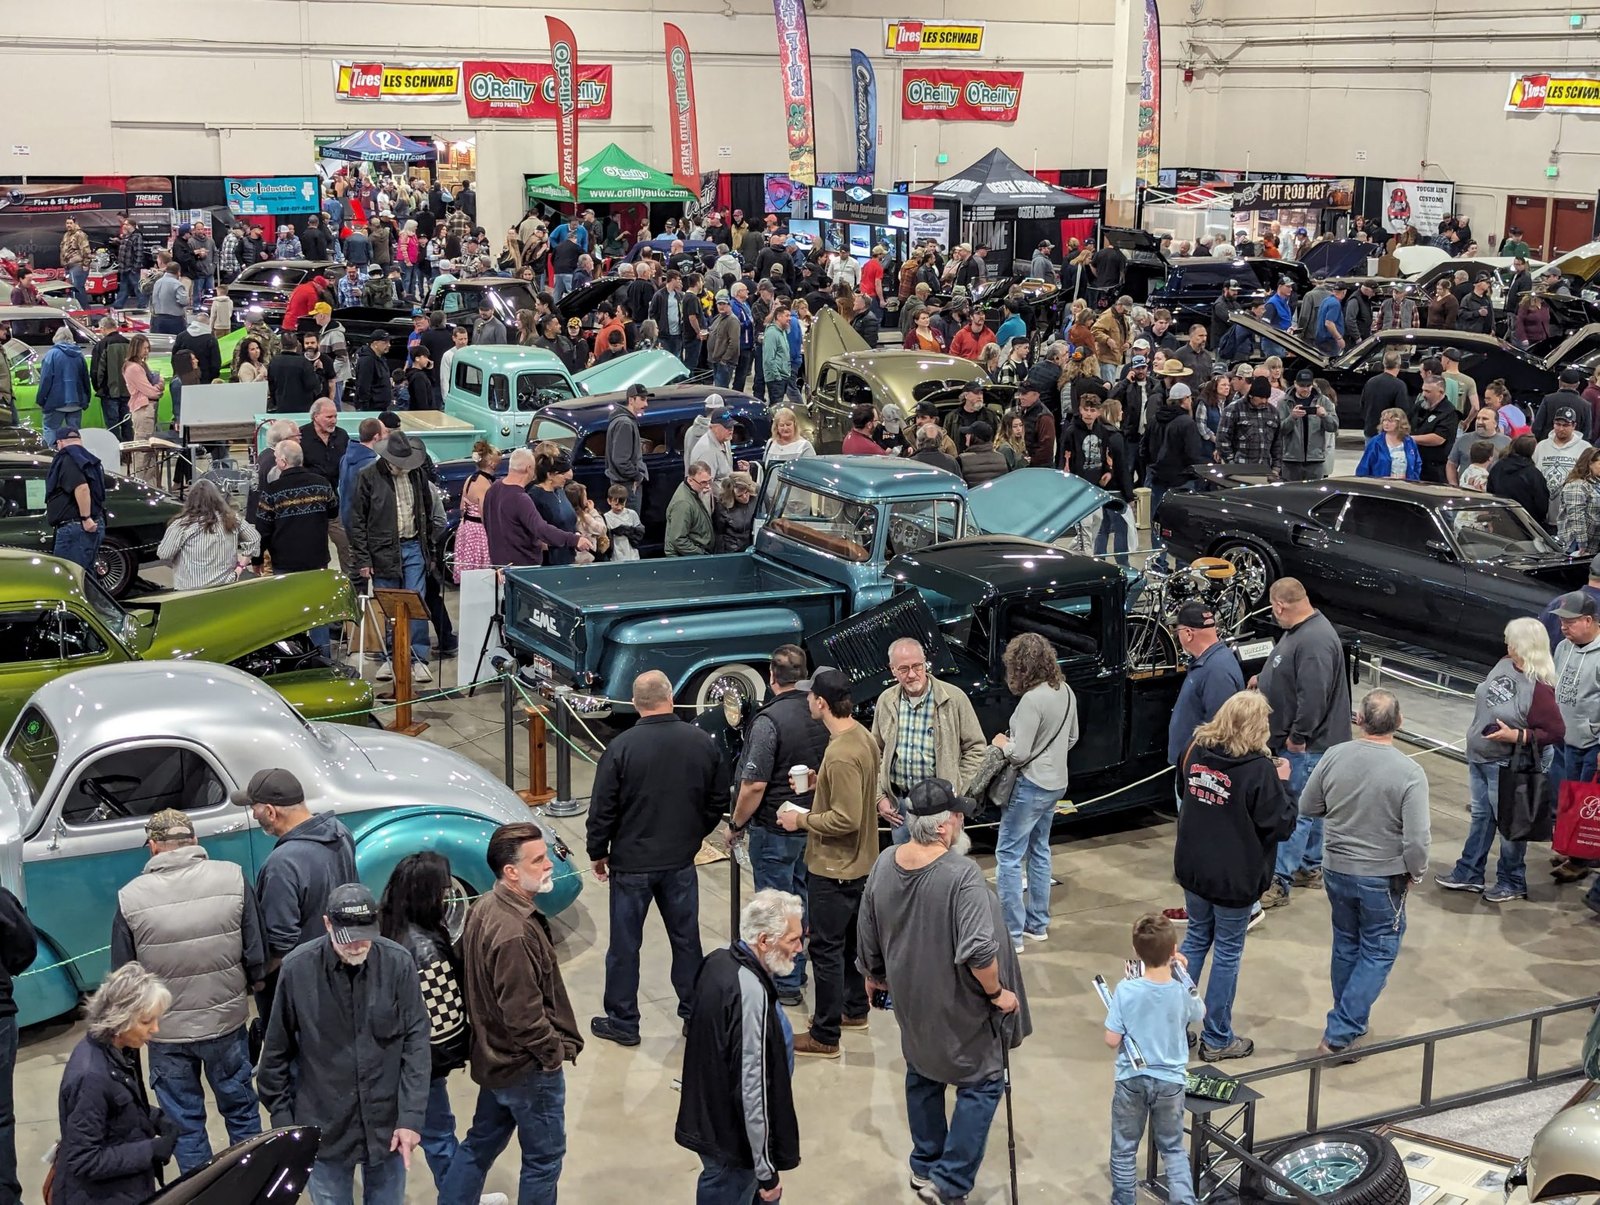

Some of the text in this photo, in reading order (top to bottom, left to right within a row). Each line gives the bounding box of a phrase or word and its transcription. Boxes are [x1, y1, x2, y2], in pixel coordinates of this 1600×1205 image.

[897, 25, 921, 45] Tires
[922, 31, 978, 44] LES SCHWAB
[352, 68, 381, 88] Tires
[383, 75, 454, 88] LES SCHWAB
[471, 75, 536, 104] O'Reilly
[908, 80, 960, 107] O'Reilly
[965, 81, 1018, 108] O'Reilly
[1547, 86, 1600, 100] LES SCHWA
[603, 166, 649, 180] O'Reilly
[589, 188, 689, 199] www.oreillyauto.com
[1262, 183, 1327, 201] HOT ROD ART
[63, 202, 102, 211] Specialists!
[69, 196, 92, 206] Speed
[1018, 205, 1034, 219] OGDEN
[1035, 205, 1056, 219] CHROME
[528, 608, 561, 638] GMC
[1189, 786, 1224, 805] GRILL
